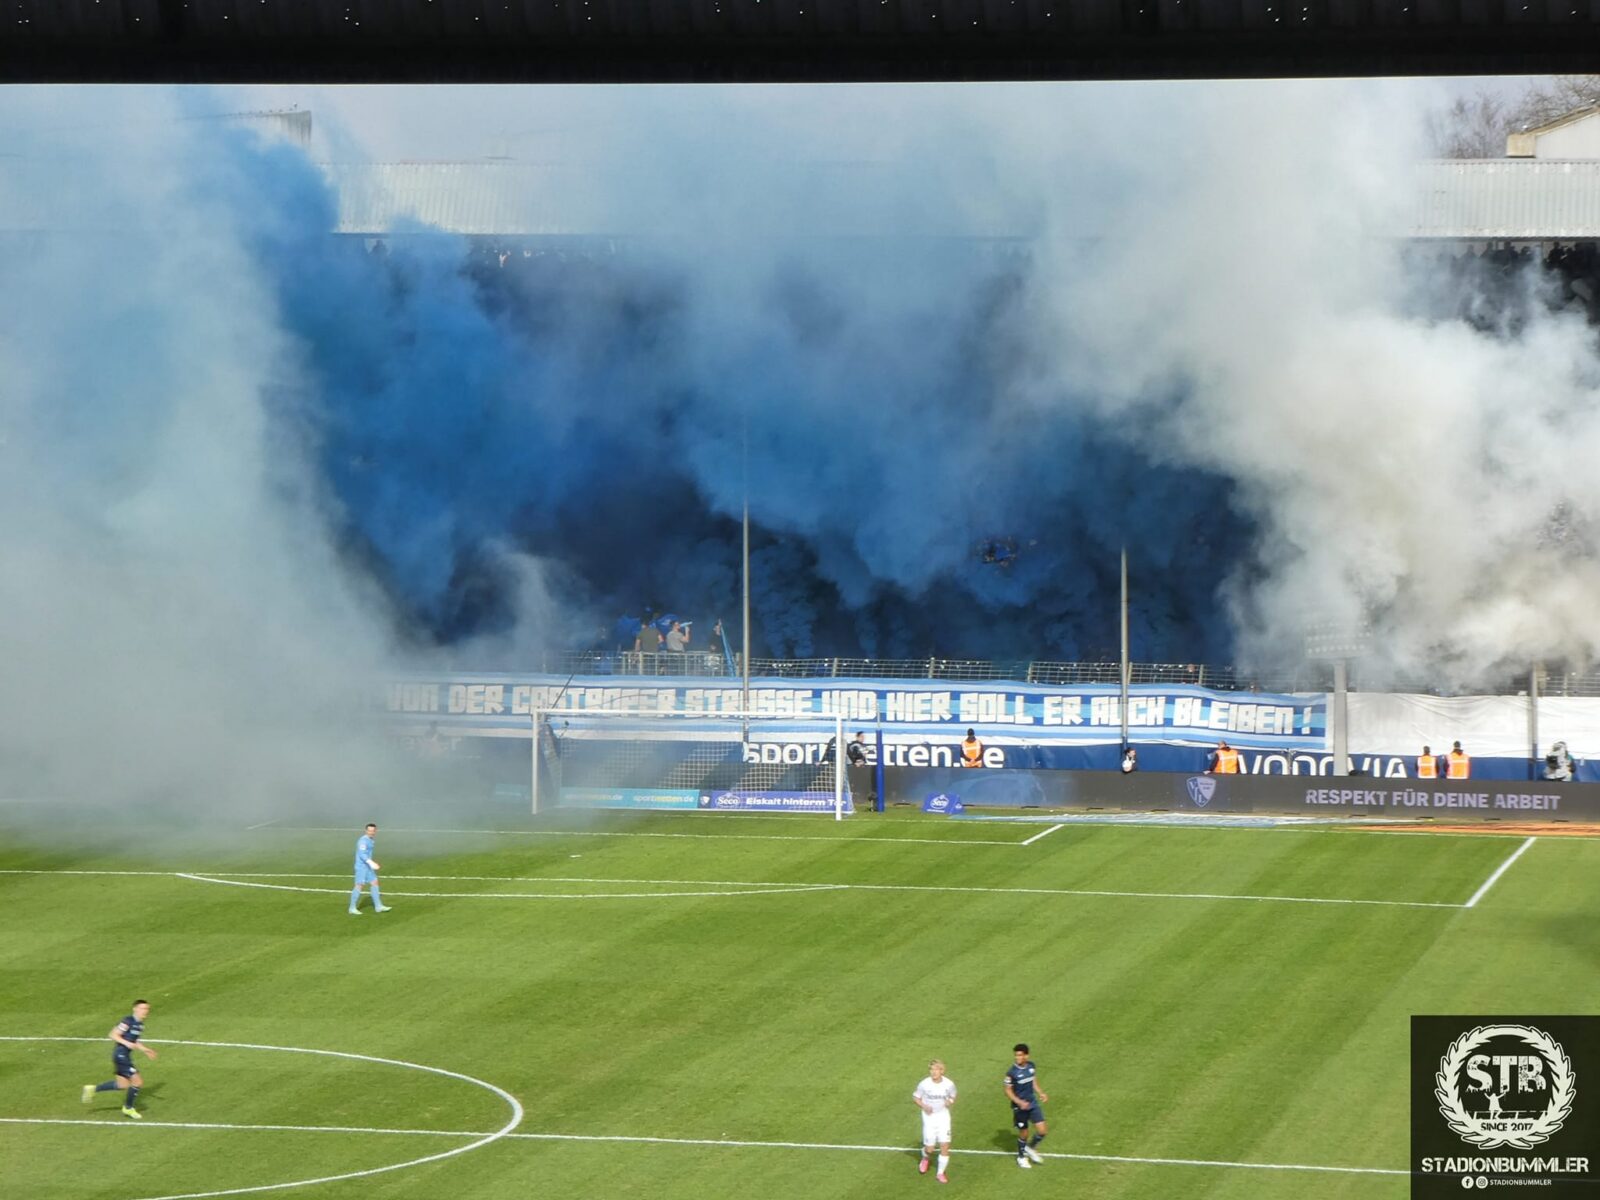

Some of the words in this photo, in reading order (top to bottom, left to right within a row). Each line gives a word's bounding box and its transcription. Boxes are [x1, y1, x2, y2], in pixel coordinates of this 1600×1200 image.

[387, 682, 440, 712] VON
[448, 684, 505, 714] DER
[684, 688, 813, 718] STRASSE
[821, 690, 878, 720] UND
[886, 691, 953, 722] HIER
[959, 693, 1033, 724] SOLL
[1042, 695, 1083, 725] ER
[1090, 696, 1166, 726] AUCH
[1173, 697, 1295, 735] BLEIBEN
[746, 797, 781, 806] Eiskalt
[782, 798, 827, 807] hinterm
[827, 799, 847, 808] Tr
[1305, 788, 1388, 806] RESPEKT
[1391, 787, 1429, 808] FÜR
[1433, 792, 1490, 809] DEINE
[1494, 793, 1562, 811] ARBEIT
